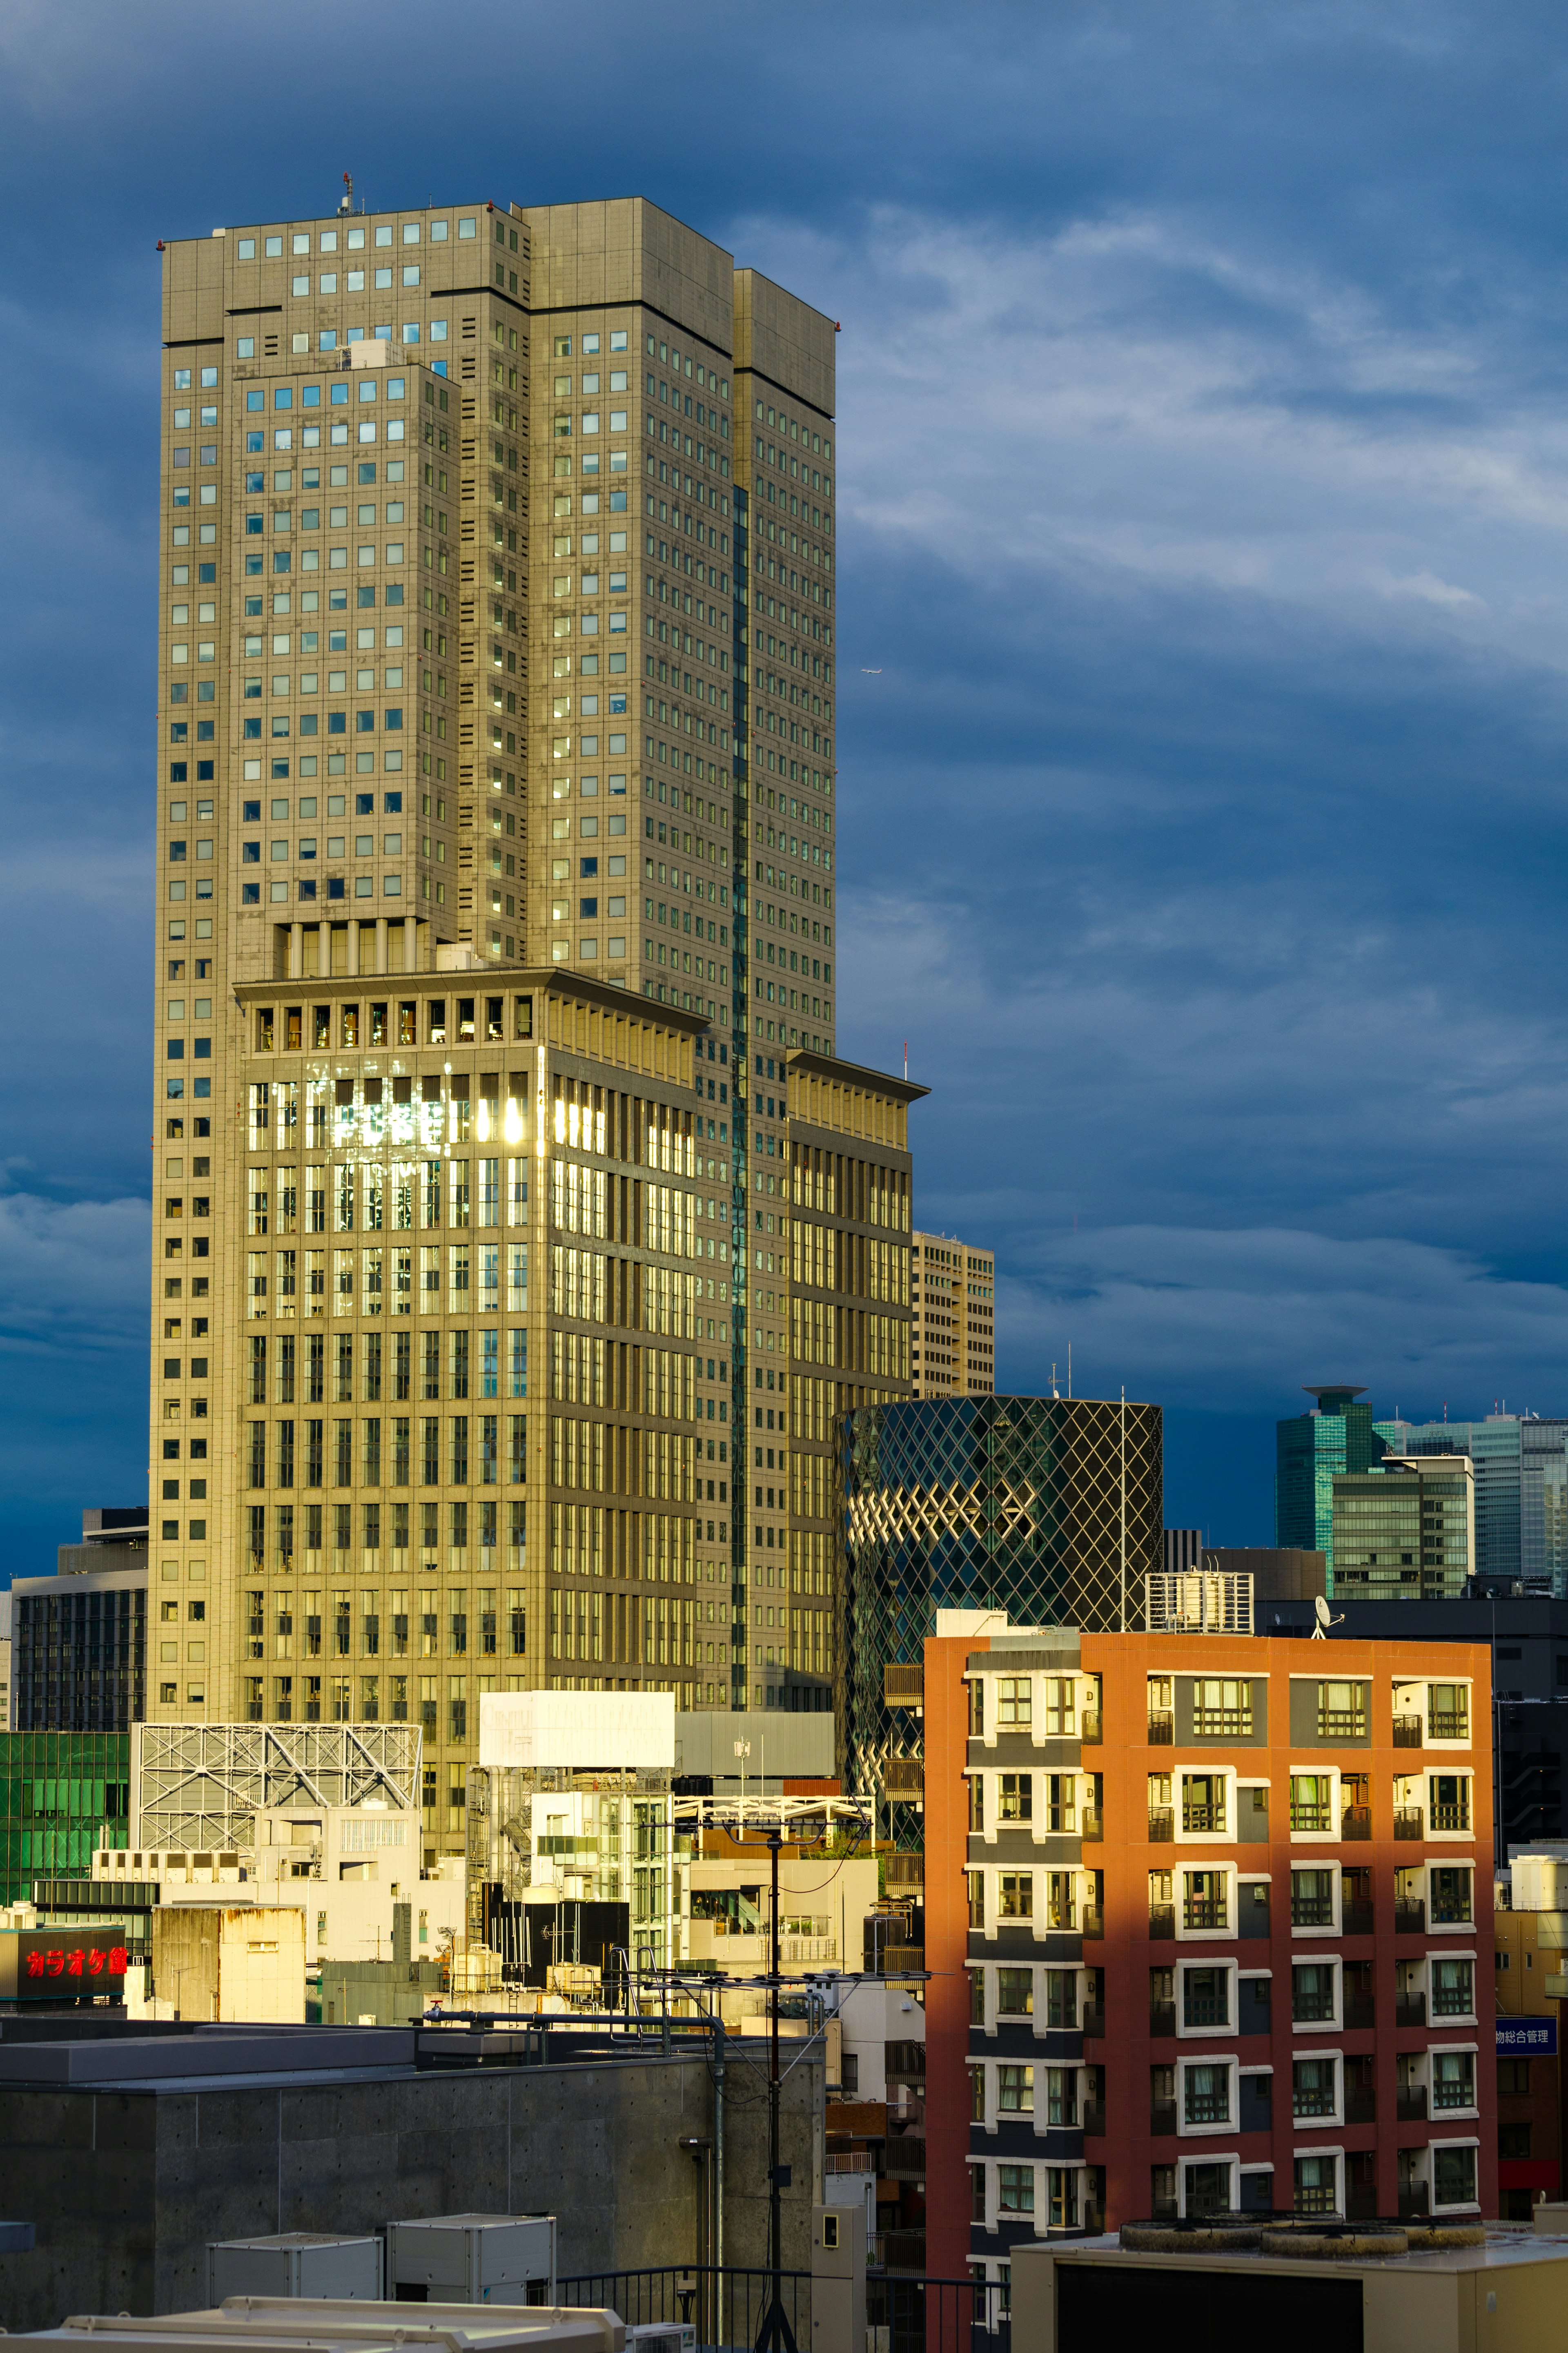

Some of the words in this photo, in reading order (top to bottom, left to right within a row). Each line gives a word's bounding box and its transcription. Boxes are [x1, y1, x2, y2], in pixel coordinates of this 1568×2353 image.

[27, 1947, 127, 1977] カラオケ館
[1496, 2030, 1548, 2044] 物総合管理
